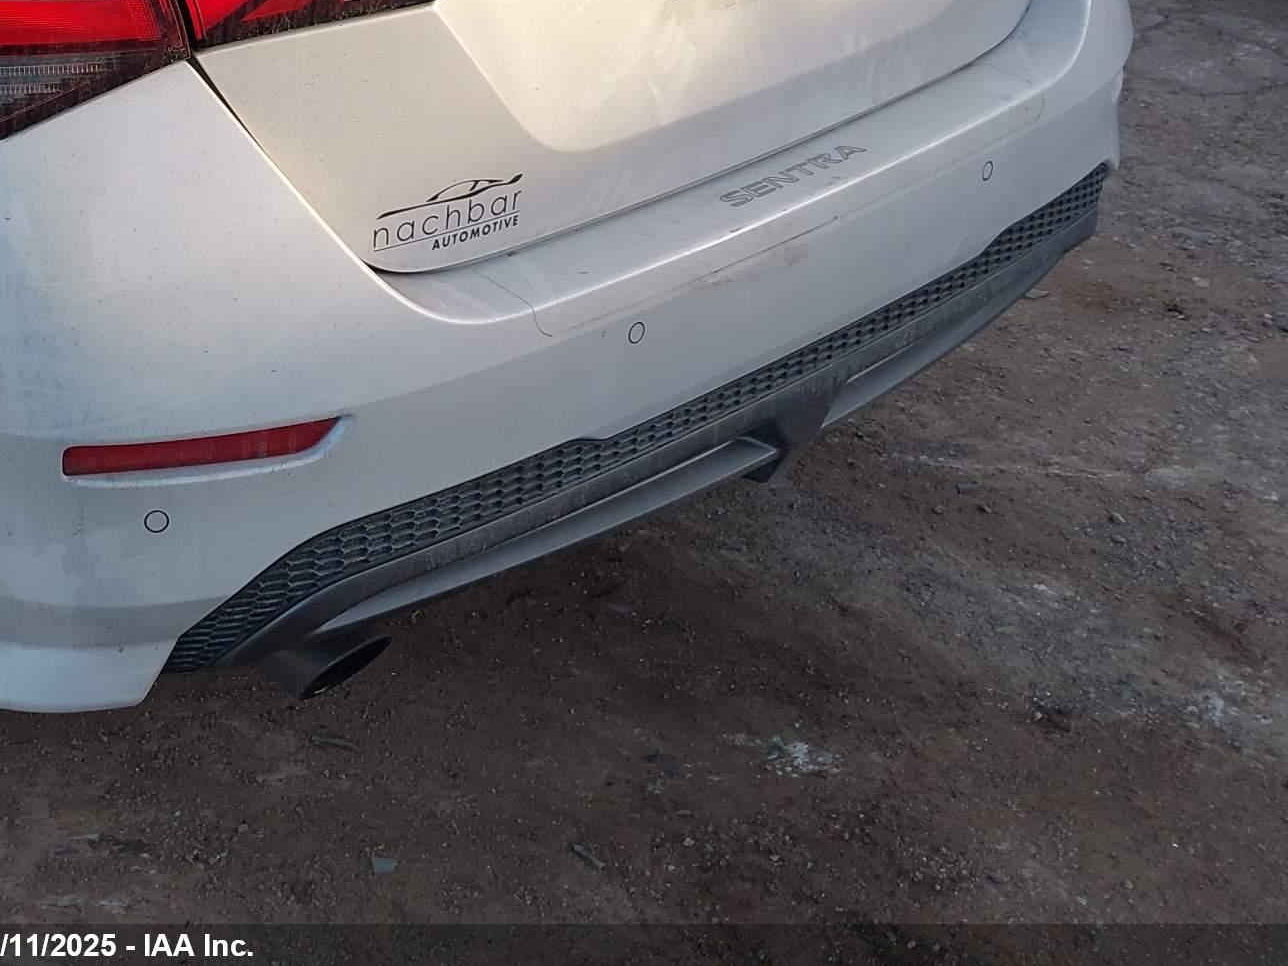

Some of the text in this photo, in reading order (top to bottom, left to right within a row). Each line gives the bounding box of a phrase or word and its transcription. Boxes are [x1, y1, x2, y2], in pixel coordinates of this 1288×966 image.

[719, 145, 868, 208] SENTRA
[372, 190, 523, 248] nachbar
[431, 214, 520, 251] AUTOMOTIVE
